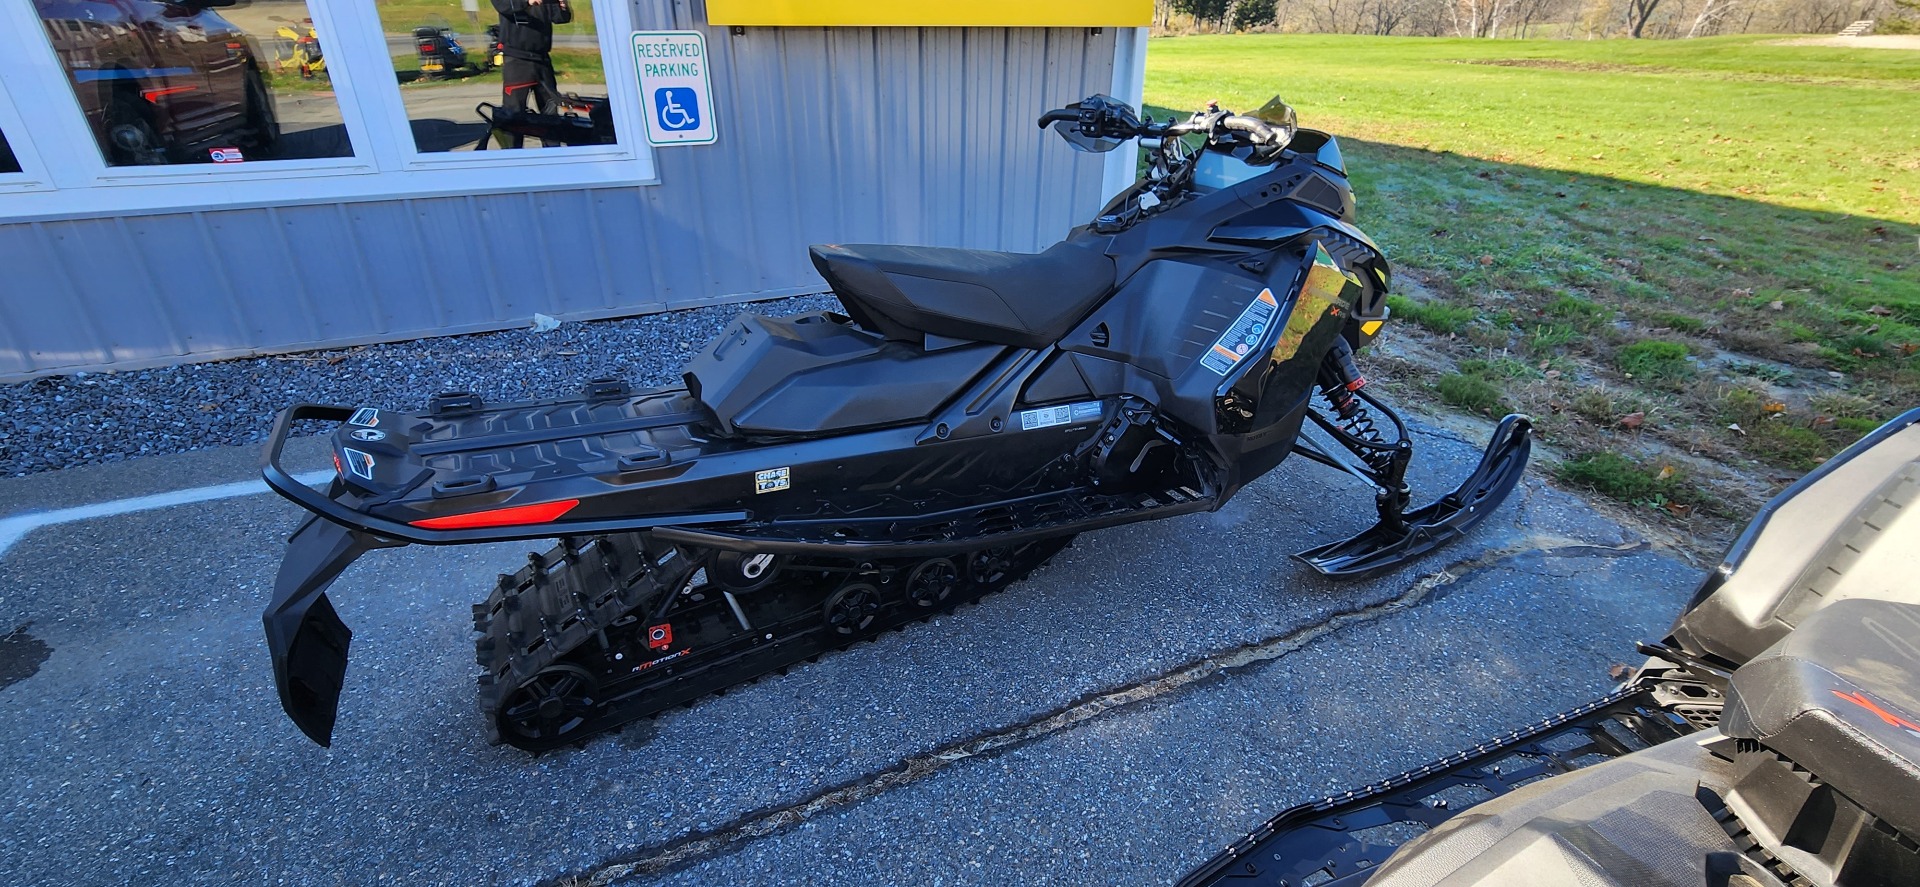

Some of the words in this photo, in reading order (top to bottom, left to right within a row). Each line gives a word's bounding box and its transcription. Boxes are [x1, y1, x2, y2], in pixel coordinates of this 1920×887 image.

[637, 43, 700, 58] RESERVED
[644, 63, 699, 77] PARKING
[758, 469, 787, 480] CHASE
[759, 479, 787, 490] TOYS
